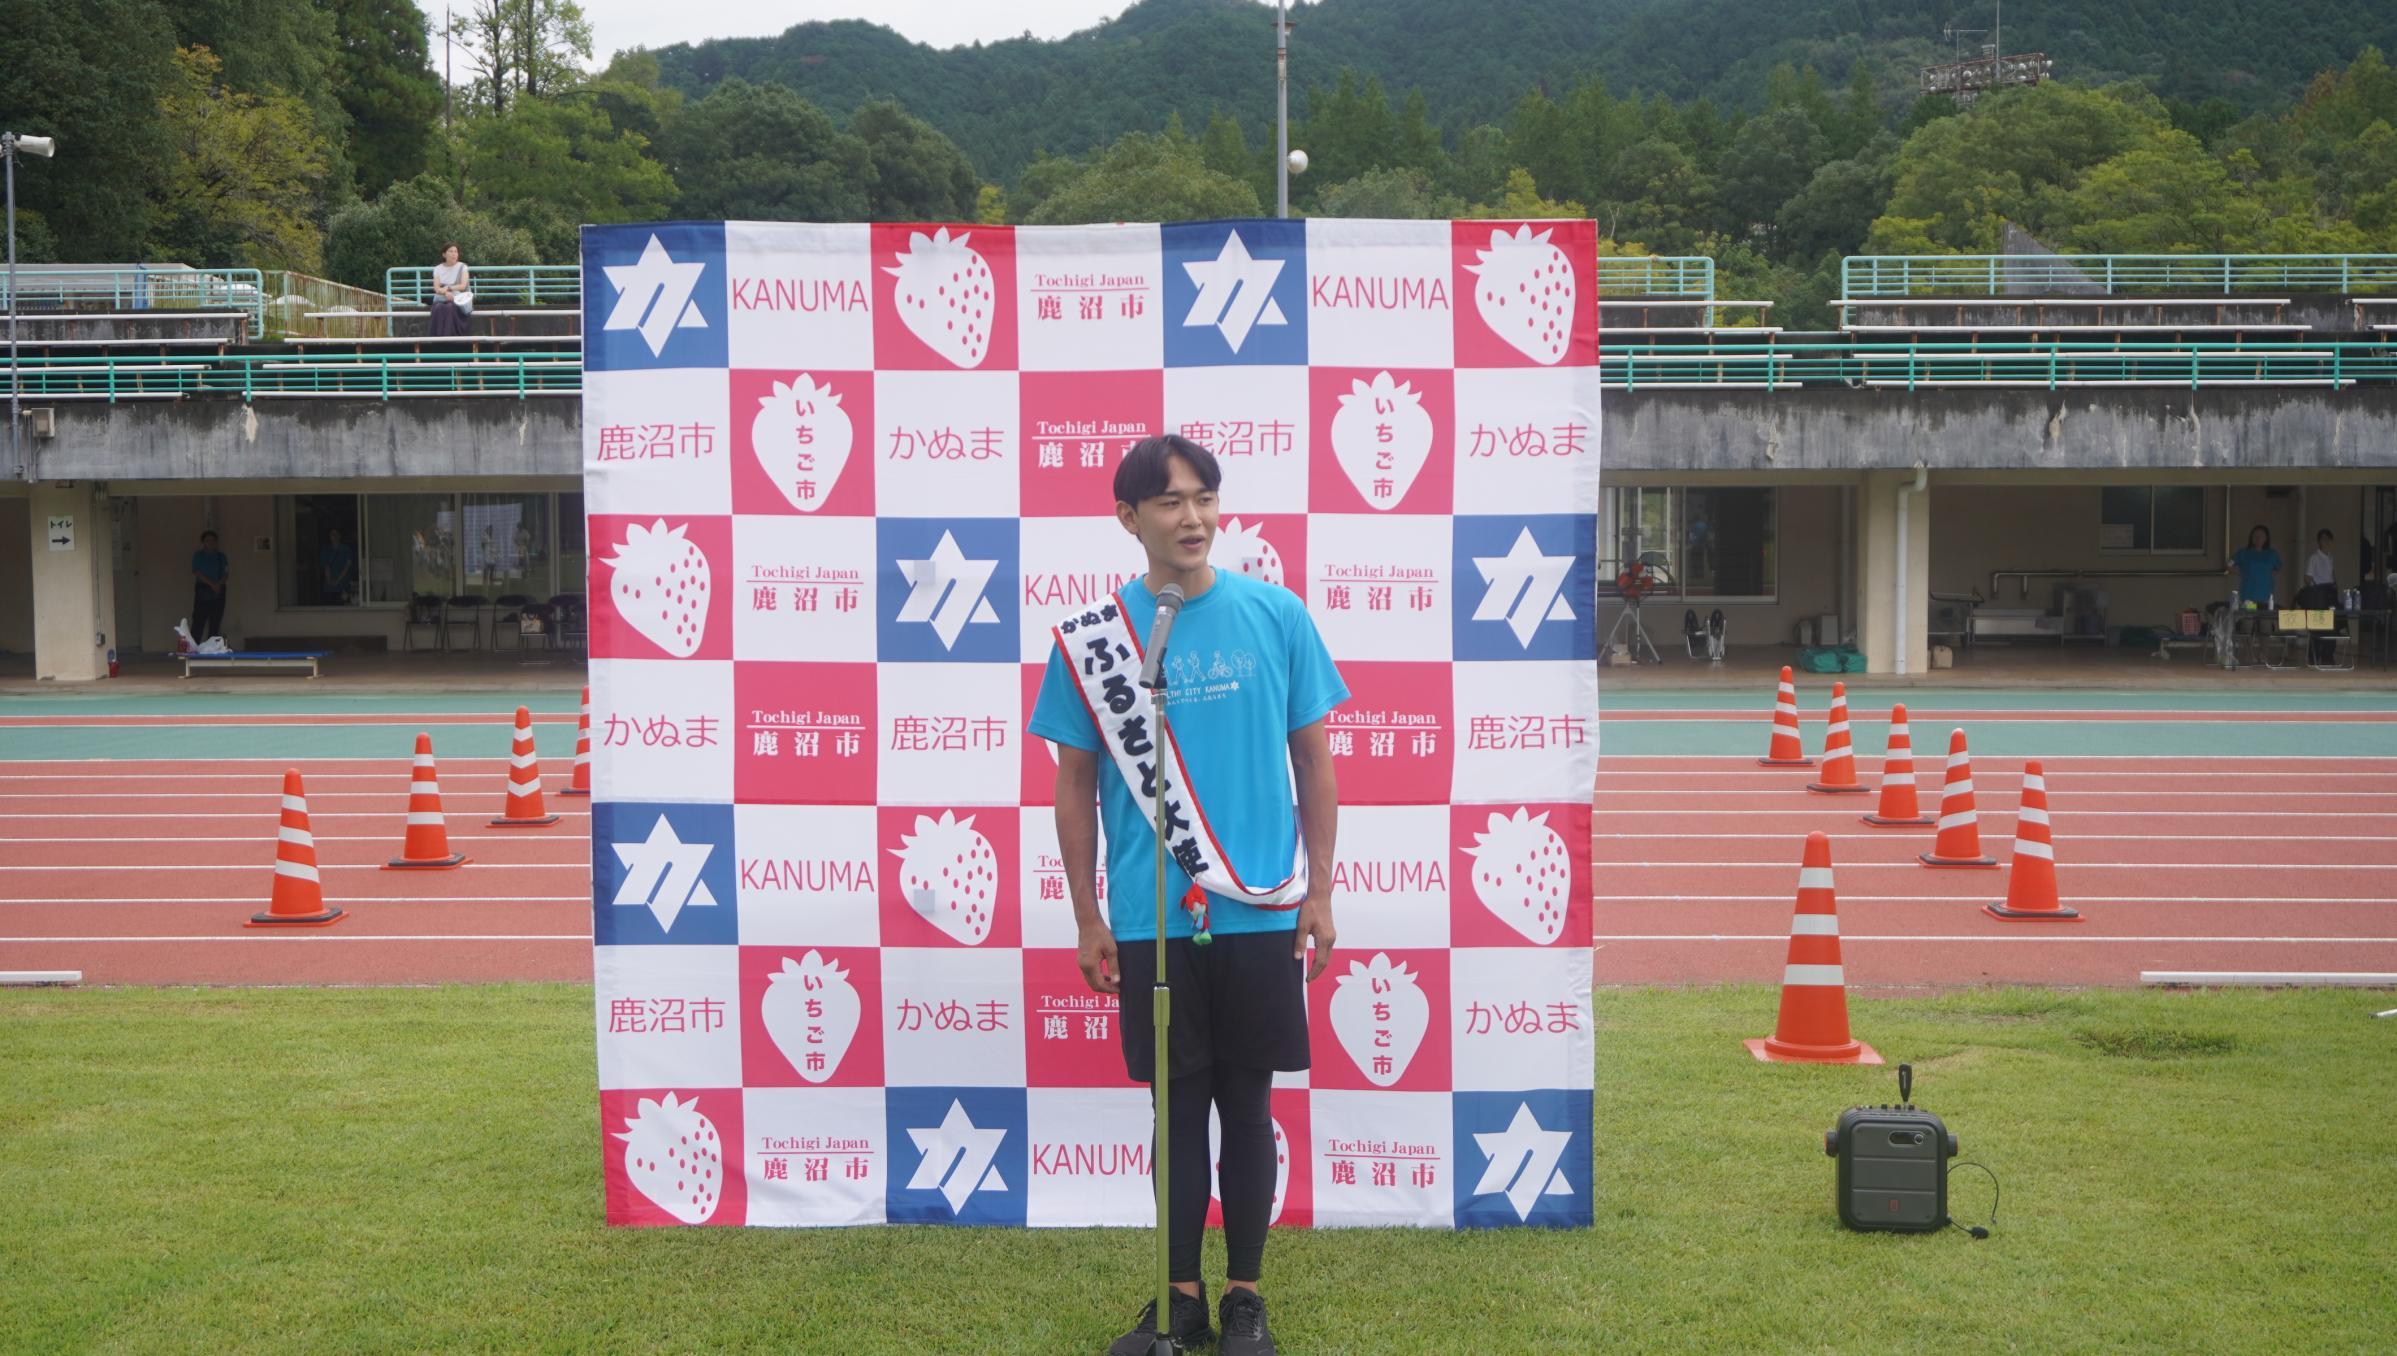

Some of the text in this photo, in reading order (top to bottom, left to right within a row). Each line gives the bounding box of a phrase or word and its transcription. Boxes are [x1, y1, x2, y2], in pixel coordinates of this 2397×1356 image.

[1036, 273, 1145, 287] Tochigi Japan
[1312, 277, 1448, 309] KANUMA
[732, 279, 868, 314] KANUMA
[1038, 294, 1144, 320] 鹿沼市
[597, 422, 715, 461] 鹿沼市
[1038, 418, 1148, 434] Tochigi Japan
[1470, 423, 1586, 459] かぬま
[795, 400, 816, 499] いちご市
[890, 426, 1004, 462] かぬま
[1373, 396, 1396, 498] いちご市
[50, 520, 72, 529] トイレ
[752, 564, 859, 581] Tochigi Japan
[1323, 563, 1436, 580] Tochigi Japan
[752, 588, 857, 613] 鹿沼市
[1026, 573, 1136, 606] KANUM
[1327, 585, 1433, 612] 鹿沼市
[1060, 603, 1118, 635] かぬま
[1185, 686, 1200, 696] CITY
[604, 712, 720, 749] かぬま
[752, 710, 862, 726] Tochigi Japan
[1328, 710, 1438, 724] Tochigi Japan
[1468, 714, 1585, 751] 鹿沼市
[751, 731, 859, 758] 鹿沼市
[892, 715, 1008, 752] 鹿沼市
[1329, 731, 1436, 757] 鹿沼市
[740, 859, 874, 892] KANUMA
[1331, 861, 1445, 892] ANUMA
[608, 997, 726, 1035] 鹿沼市
[896, 998, 1009, 1033] かぬま
[1041, 995, 1099, 1008] Tochigi
[803, 975, 826, 1072] いちご市
[1044, 1015, 1108, 1040] 鹿沼
[1371, 978, 1393, 1075] いちご市
[1465, 1001, 1580, 1035] かぬま
[762, 1136, 868, 1153] Tochigi Japan
[1032, 1142, 1153, 1177] KANUM
[1328, 1137, 1436, 1156] Tochigi Japan
[763, 1156, 868, 1182] 鹿沼市
[1331, 1161, 1435, 1189] 鹿沼市
